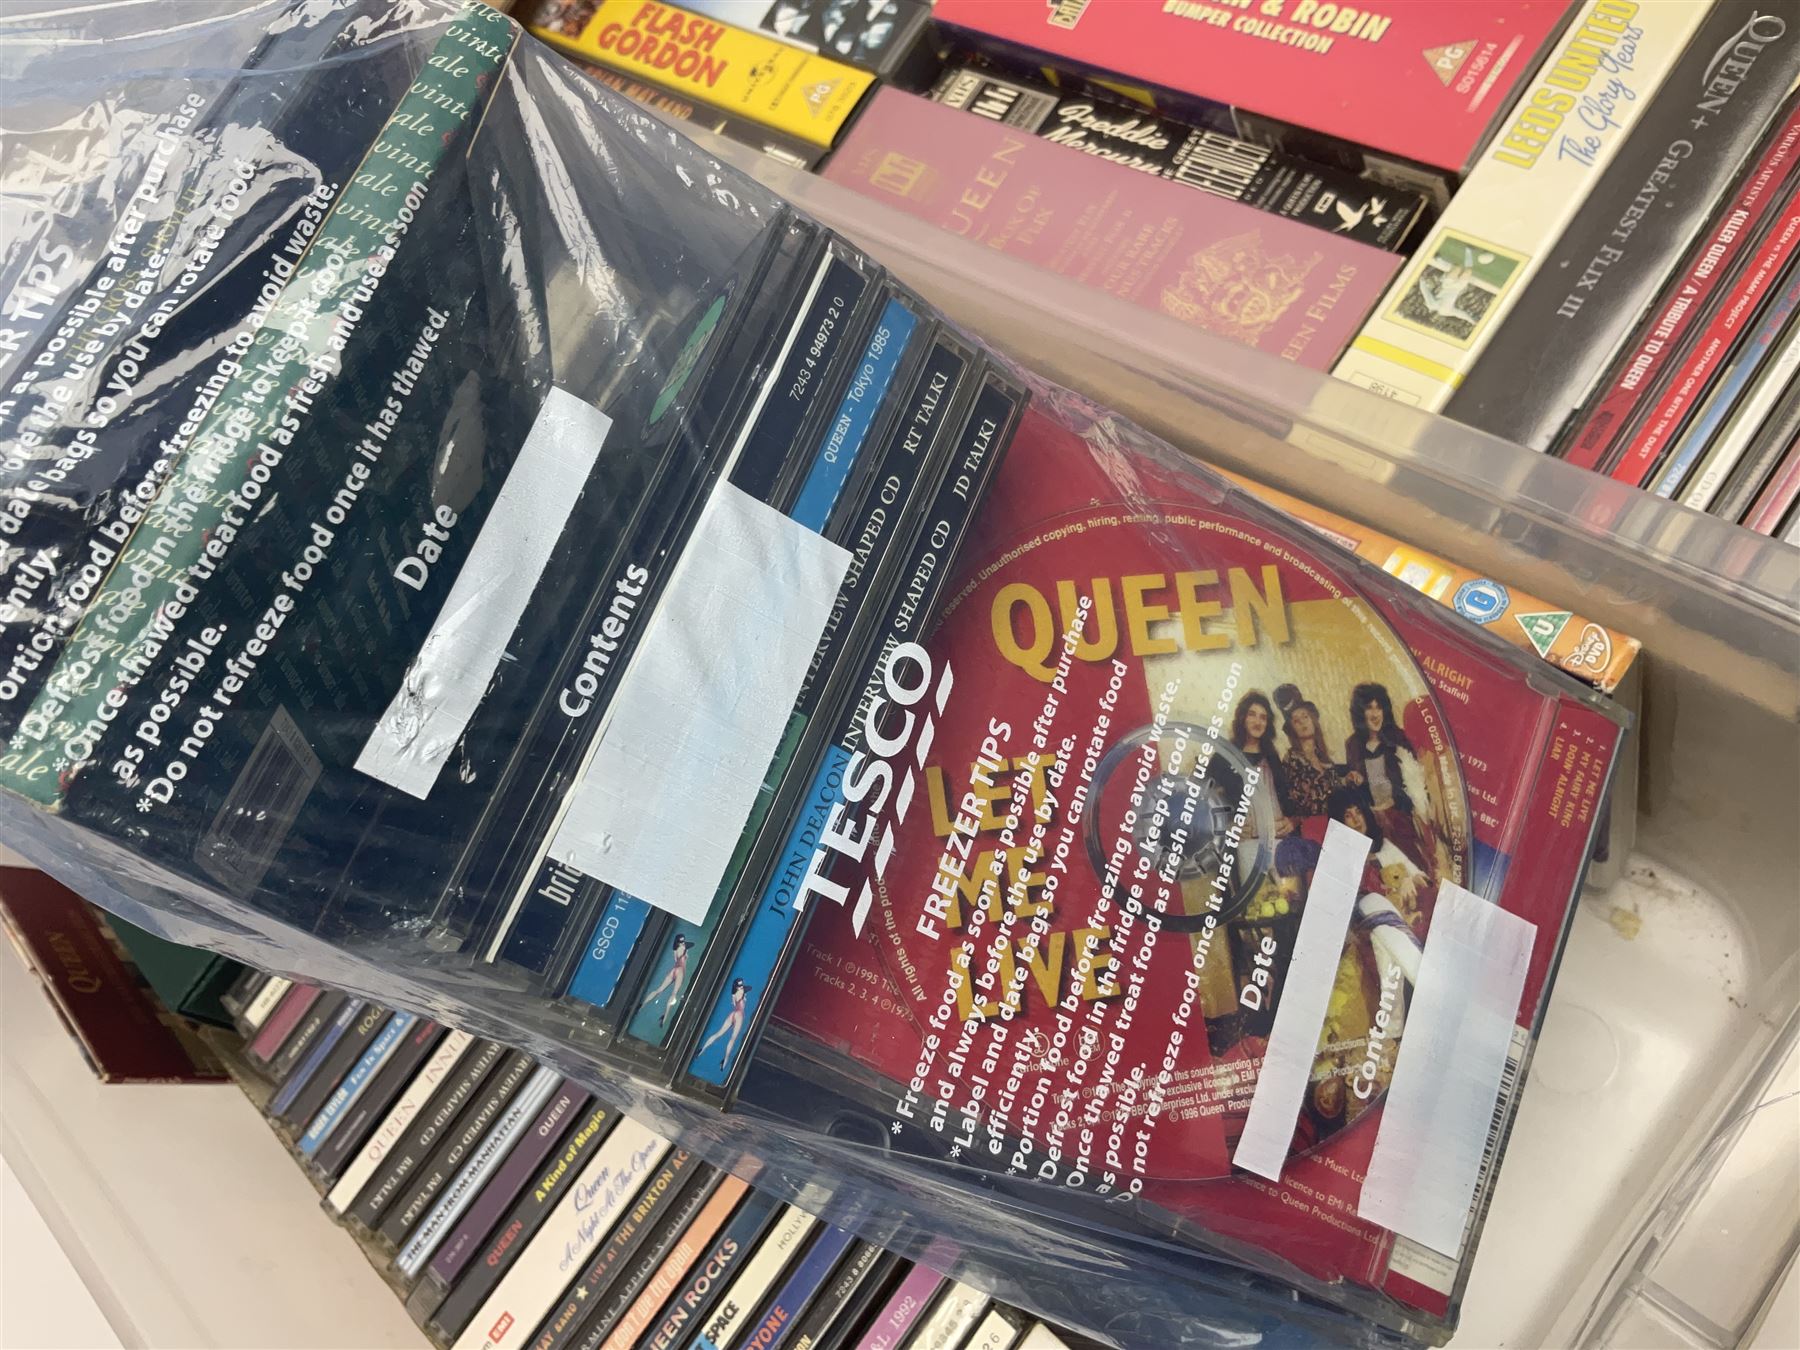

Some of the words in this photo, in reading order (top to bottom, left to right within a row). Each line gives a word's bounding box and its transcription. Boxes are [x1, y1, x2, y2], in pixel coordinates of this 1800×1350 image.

[631, 2, 727, 52] FLASH
[1163, 0, 1231, 28] BUMPER
[1233, 15, 1335, 54] COLLECTION
[1292, 0, 1392, 43] ROBIN
[1599, 21, 1643, 73] Years
[598, 23, 728, 87] GORDON
[1436, 46, 1465, 70] PG
[1697, 10, 1786, 115] QUEEN
[1493, 88, 1576, 169] LEEDS
[1545, 0, 1640, 92] UNITED
[1578, 78, 1636, 131] Glory
[1058, 103, 1170, 150] Freddie
[1558, 135, 1601, 167] The
[1612, 139, 1694, 243] GREATEST
[1742, 168, 1774, 208] ARTISTS
[34, 275, 115, 367] possible
[107, 205, 147, 272] after
[140, 93, 206, 203] purchase
[1718, 210, 1749, 243] KILLER
[10, 239, 73, 321] TIPS
[1577, 245, 1623, 290] FLIX
[1694, 243, 1727, 279] QUEEN
[63, 339, 105, 380] use
[124, 247, 170, 309] date.
[106, 339, 150, 397] you
[140, 296, 179, 339] can
[172, 225, 226, 297] rotate
[159, 358, 242, 456] freezing
[246, 253, 296, 329] avoid
[285, 182, 339, 259] waste.
[1557, 295, 1584, 320] III
[1654, 296, 1693, 338] TRIBUTE
[1725, 295, 1751, 329] PROJECT
[230, 443, 283, 512] food
[284, 353, 337, 415] fresh
[327, 300, 364, 351] and
[393, 181, 429, 235] soon
[789, 366, 813, 401] 7243
[810, 317, 838, 363] 94973
[1621, 353, 1653, 390] QUEEN
[1645, 338, 1664, 354] TO
[1695, 338, 1721, 377] ANOTHER
[824, 414, 853, 463] QUEEN
[848, 364, 875, 404] Tokyo
[867, 327, 891, 368] 1985
[1682, 377, 1696, 395] ONE
[848, 507, 887, 589] SHAPED
[880, 475, 902, 505] CD
[902, 427, 923, 455] RT
[914, 372, 949, 427] TALKI
[179, 704, 223, 758] not
[213, 586, 294, 705] refreeze
[282, 522, 335, 592] food
[326, 461, 371, 524] once
[365, 396, 402, 442] has
[392, 306, 450, 396] thawed.
[393, 503, 457, 591] Date
[978, 536, 1042, 580] Unauthorised
[1042, 519, 1087, 543] copying,
[1087, 513, 1122, 530] hiring,
[1165, 514, 1197, 527] public
[1198, 519, 1263, 546] performance
[1283, 550, 1342, 599] broadcasting
[558, 563, 649, 718] Contents
[991, 564, 1291, 683] QUEEN
[767, 854, 805, 917] JOHN
[801, 753, 848, 853] DEACON
[894, 552, 937, 632] SHAPED
[930, 519, 951, 550] CD
[953, 474, 972, 502] JD
[963, 419, 997, 473] TALKI
[1423, 655, 1474, 690] ALRIGHT
[1585, 641, 1605, 664] DVD
[135, 623, 228, 746] possible.
[793, 641, 932, 913] TESCO
[1467, 755, 1487, 772] 1973
[1570, 770, 1585, 799] FAIRY
[1580, 752, 1591, 768] MY
[1592, 759, 1603, 778] LET
[925, 753, 1060, 837] LET
[1088, 840, 1132, 930] freezing
[1131, 742, 1157, 808] avoid
[1151, 678, 1181, 744] waste.
[1548, 774, 1568, 819] ALRIGHT
[1578, 799, 1591, 823] LIVE
[1585, 780, 1597, 796] ME
[916, 787, 988, 940] FREEZER
[970, 717, 1012, 787] TIPS
[1016, 906, 1050, 962] bags
[1079, 711, 1109, 780] rotate
[1561, 801, 1576, 828] KING
[896, 1034, 941, 1120] Freeze
[967, 879, 999, 936] soon
[1000, 749, 1040, 847] possible
[1034, 692, 1061, 749] after
[1052, 595, 1093, 696] purchase
[1109, 883, 1143, 958] fridge
[1168, 727, 1192, 776] cool.
[1083, 1032, 1126, 1124] thawed
[1115, 972, 1144, 1031] treat
[1217, 662, 1242, 714] soon
[592, 915, 620, 960] GSCD
[1143, 1030, 1184, 1128] refreeze
[1193, 915, 1218, 968] once
[1224, 766, 1261, 850] thawed.
[898, 948, 918, 984] rights
[1240, 935, 1277, 1011] Date
[912, 986, 927, 1002] All
[948, 992, 988, 1078] always
[975, 910, 1016, 989] before
[1352, 962, 1401, 1100] Contents
[988, 1026, 1041, 1155] efficiently.
[1166, 1082, 1202, 1097] exclusive
[1190, 1067, 1214, 1080] sound
[434, 1081, 471, 1128] SHAPED
[462, 1097, 499, 1146] SHAPED
[538, 1096, 571, 1137] QUEEN
[1105, 1062, 1147, 1168] possible.
[1180, 1108, 1198, 1120] 1996
[1199, 1104, 1225, 1118] Queen
[543, 1160, 567, 1191] Kind
[565, 1144, 578, 1162] of
[575, 1109, 606, 1150] Magic
[1324, 1157, 1349, 1177] Music
[1280, 1191, 1309, 1213] Queen
[1311, 1205, 1362, 1236] Productions
[1284, 1175, 1313, 1196] licence
[1327, 1194, 1343, 1209] EMI
[554, 1303, 577, 1332] BAND
[614, 1222, 635, 1246] THE
[633, 1169, 674, 1224] BRIXTON
[684, 1238, 739, 1309] ROCKS
[705, 1300, 739, 1344] SPACE
[889, 1295, 917, 1329] 1992
